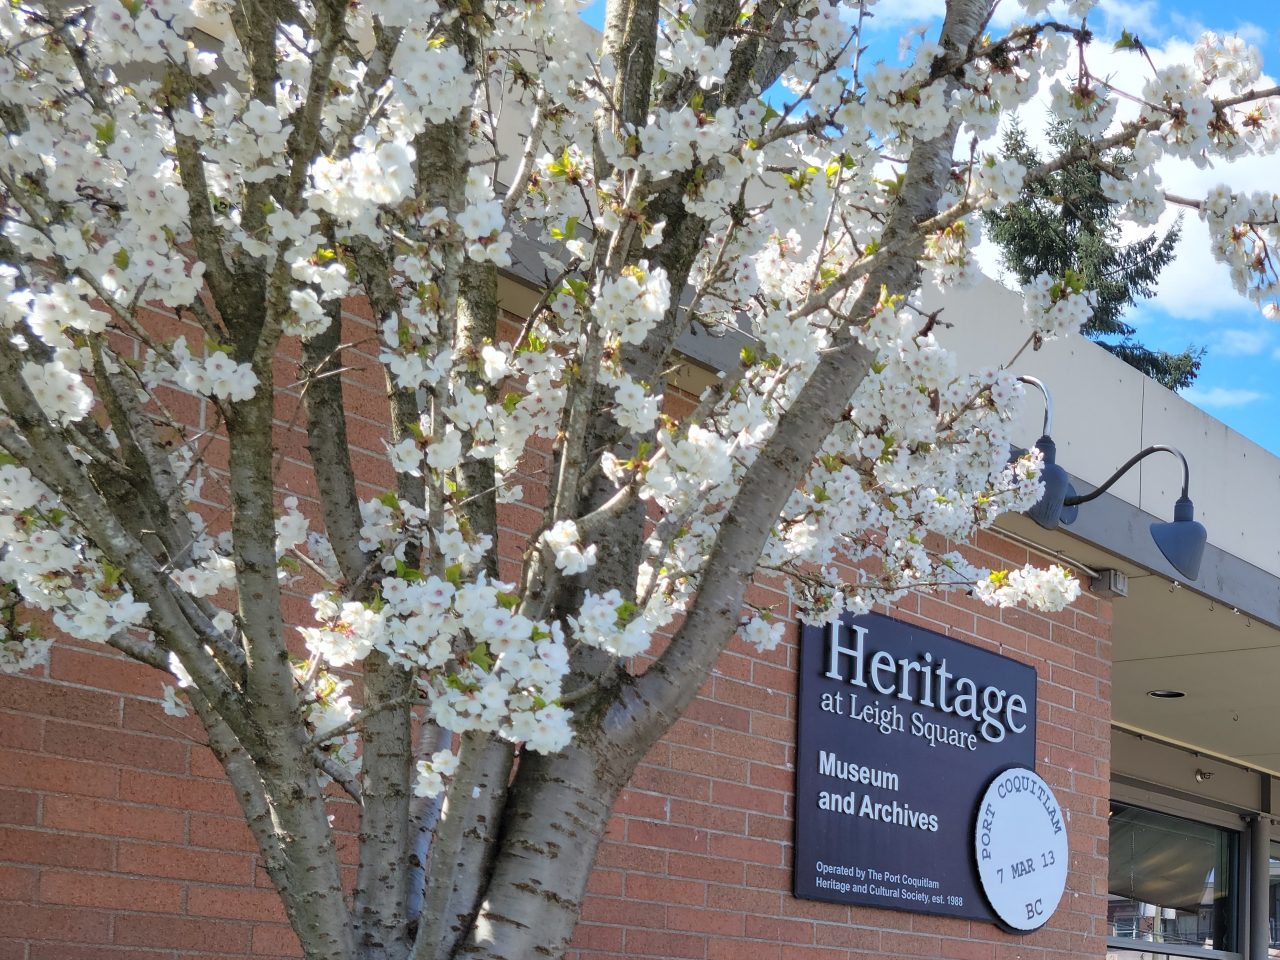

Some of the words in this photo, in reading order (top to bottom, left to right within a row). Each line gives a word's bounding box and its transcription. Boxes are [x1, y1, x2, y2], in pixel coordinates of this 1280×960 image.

[825, 620, 1028, 743] Heritage
[821, 691, 843, 715] at
[849, 693, 905, 735] Leigh
[911, 711, 978, 751] Square
[819, 750, 899, 791] Museum
[818, 791, 855, 815] and
[858, 794, 939, 832] Archives
[981, 803, 996, 861] PORT
[997, 775, 1062, 835] COQUITLAM
[816, 861, 854, 878] Operated
[856, 867, 866, 880] by
[868, 869, 882, 881] The
[884, 872, 901, 884] Port
[901, 874, 940, 889] Coquitlam
[996, 868, 1004, 884] 7
[1011, 857, 1035, 880] MAR
[1041, 850, 1056, 869] 13
[816, 877, 850, 893] Heritage
[852, 884, 867, 894] and
[869, 884, 900, 898] Cultural
[901, 889, 930, 905] Society,
[947, 896, 963, 907] 1988
[1025, 898, 1043, 920] BC
